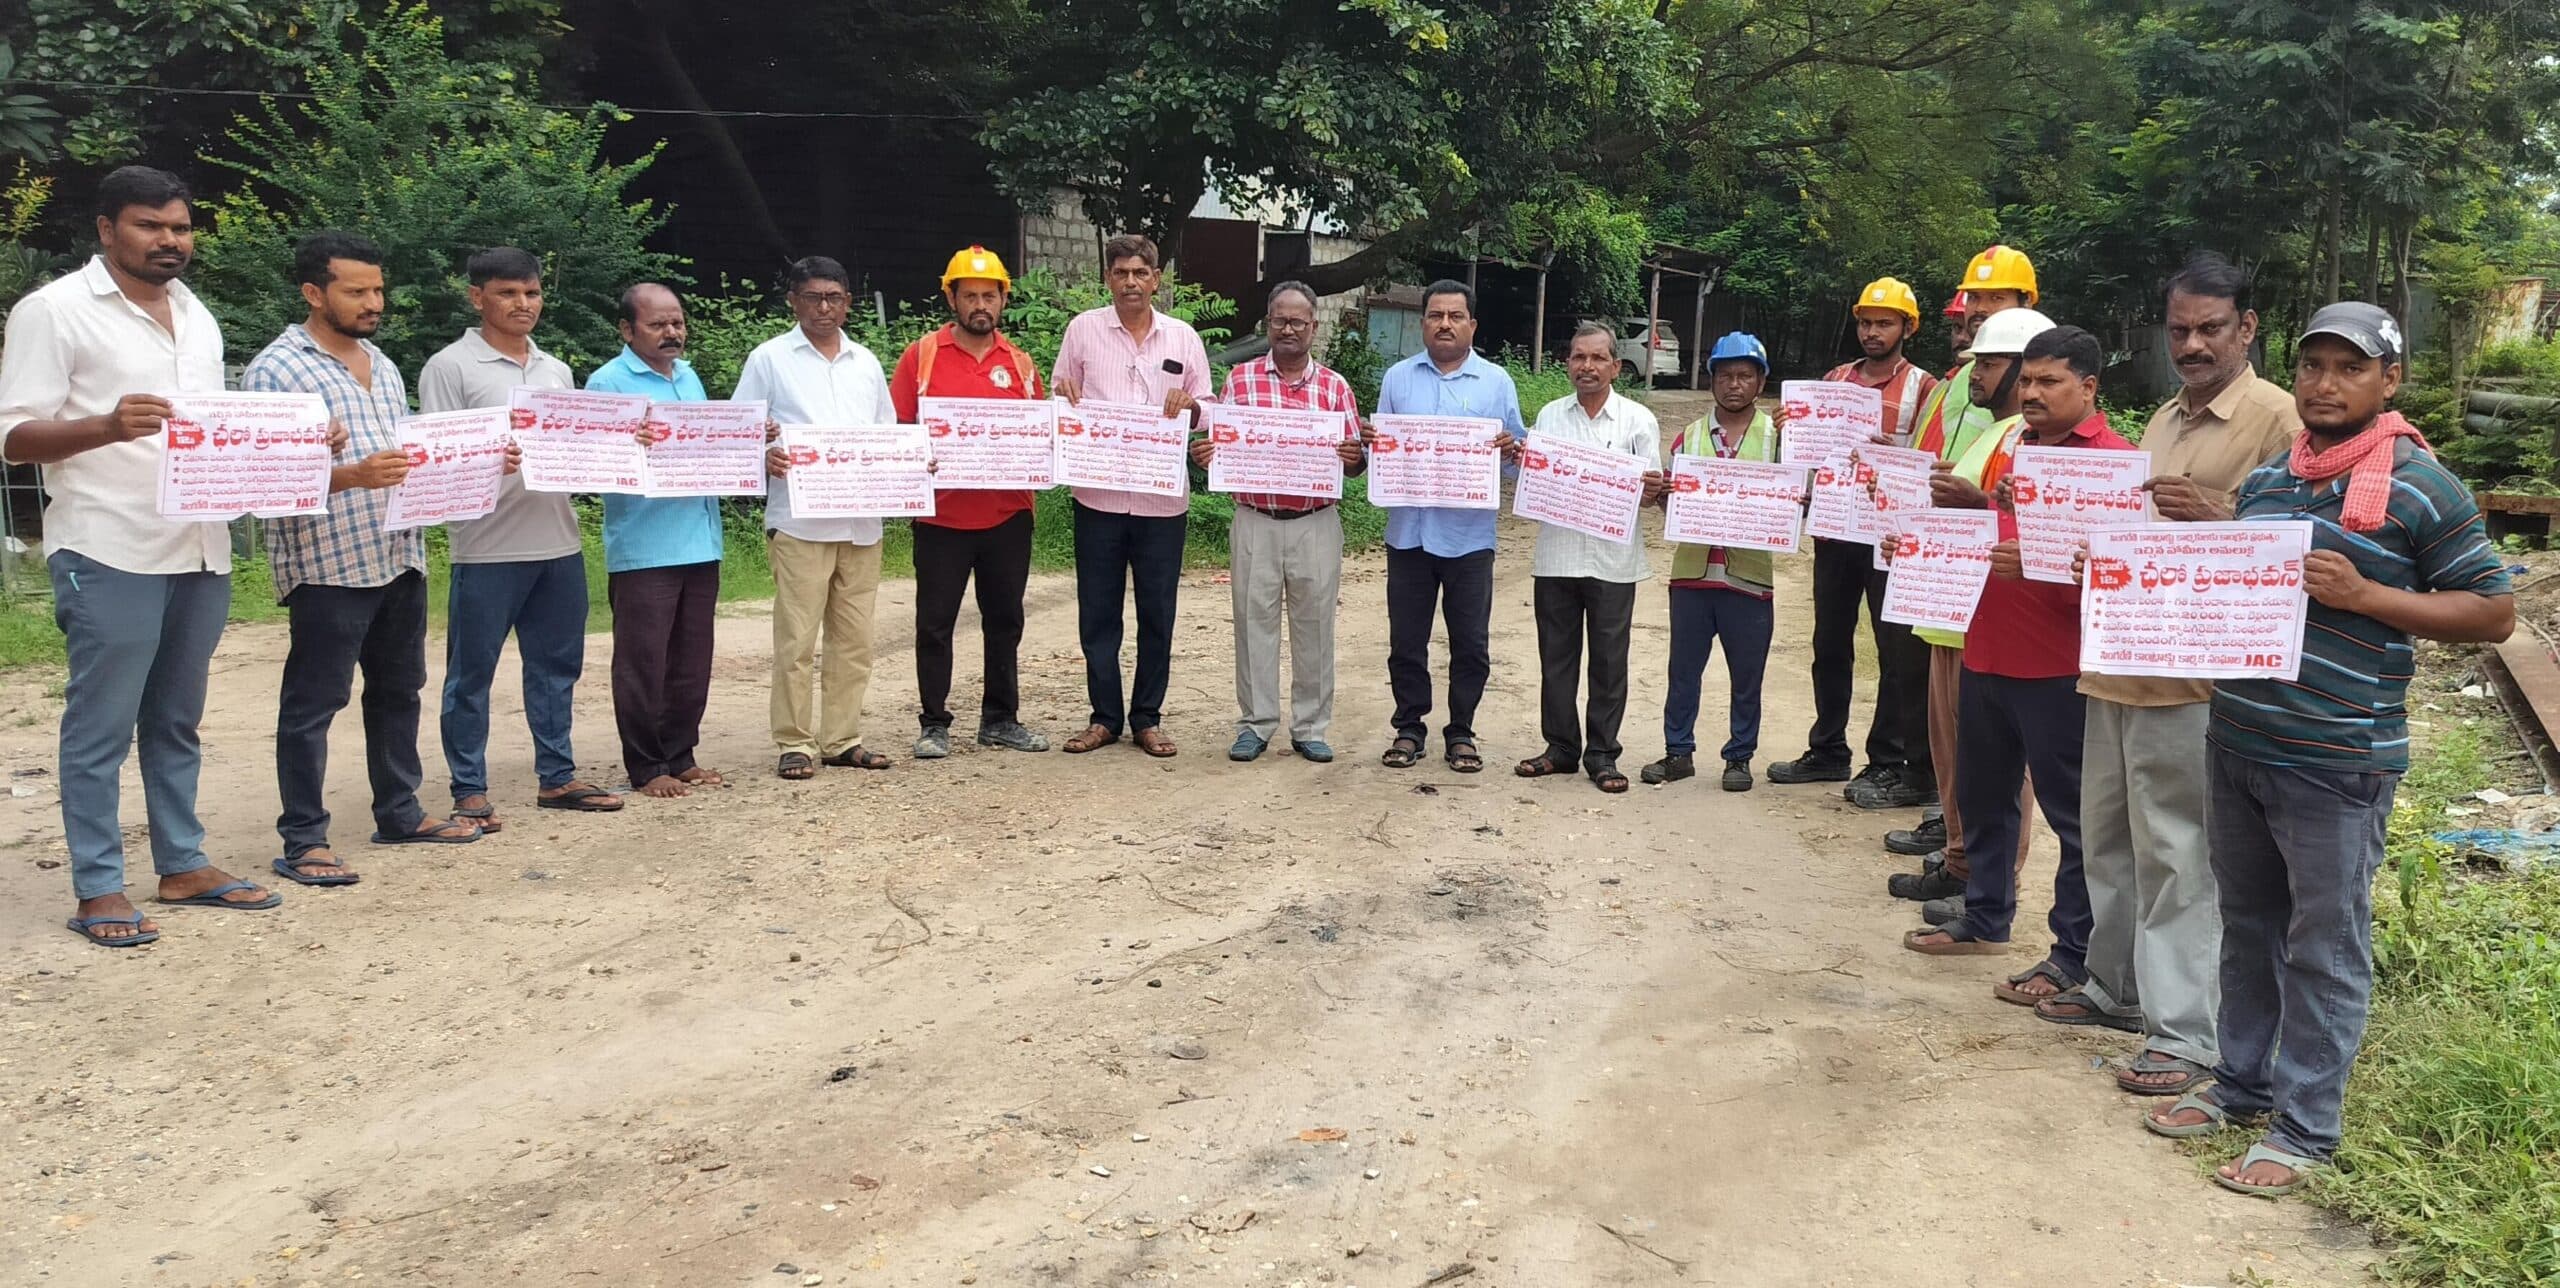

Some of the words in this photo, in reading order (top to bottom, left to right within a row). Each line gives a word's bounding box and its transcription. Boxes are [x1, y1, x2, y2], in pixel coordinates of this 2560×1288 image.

[616, 477, 638, 486] JAC
[1152, 480, 1175, 489] JAC
[1312, 483, 1333, 491] JAC
[1466, 492, 1488, 500] JAC
[2042, 480, 2071, 510] ఛలో
[2073, 486, 2144, 512] ప్రజాభవన్
[295, 497, 318, 508] JAC
[1602, 524, 1625, 536] JAC
[1767, 537, 1789, 546] JAC
[2134, 546, 2164, 558] ఇచ్చిన
[2168, 546, 2206, 554] హామీల
[2209, 546, 2255, 557] అమలుకై
[2139, 560, 2187, 594] ఛలో
[2191, 559, 2300, 593] ప్రజాభవన్
[1949, 612, 1968, 622] JAC
[2244, 654, 2282, 668] JAC
